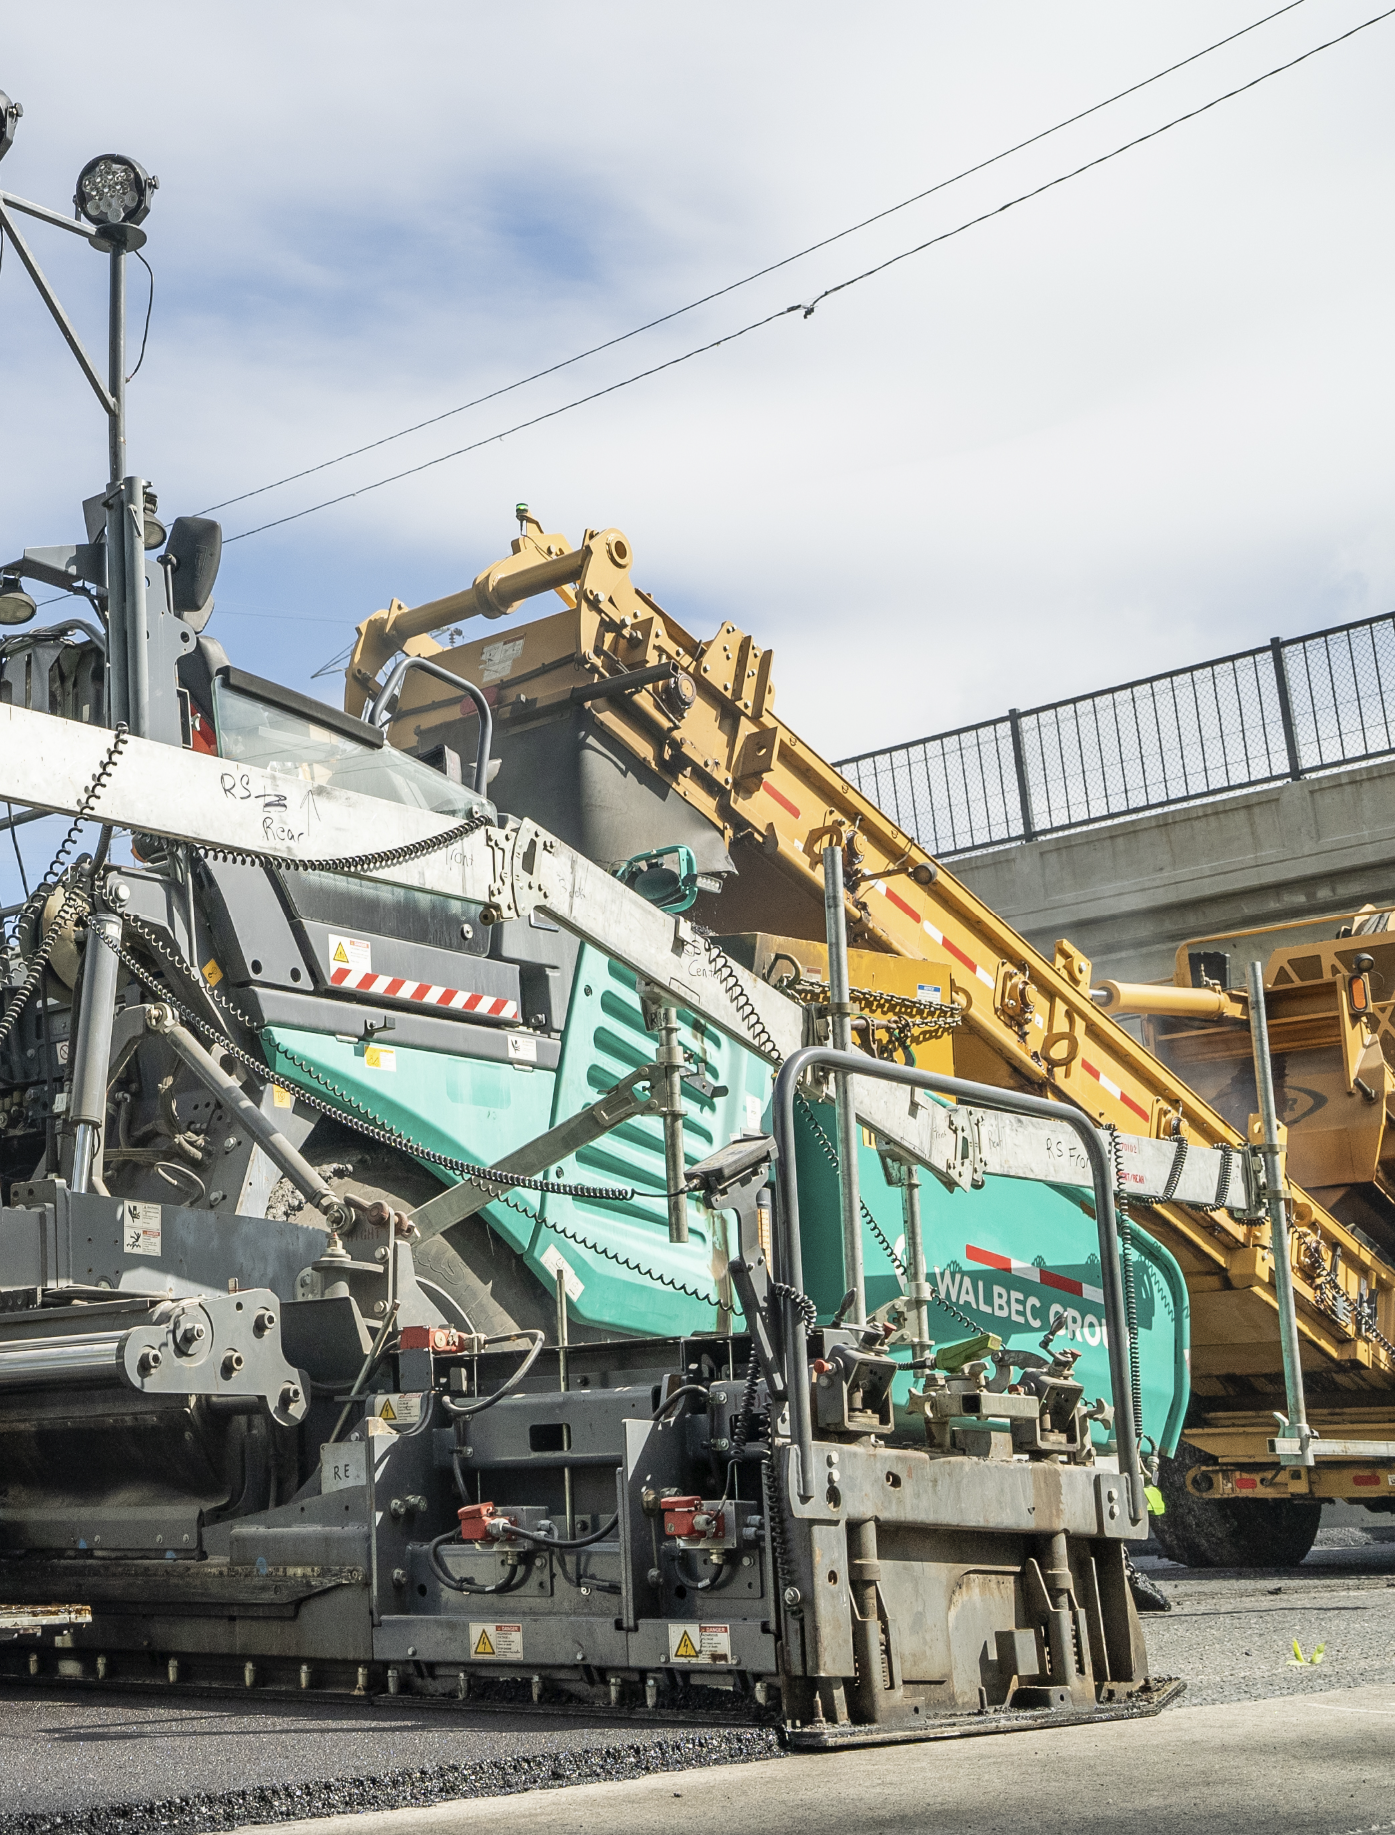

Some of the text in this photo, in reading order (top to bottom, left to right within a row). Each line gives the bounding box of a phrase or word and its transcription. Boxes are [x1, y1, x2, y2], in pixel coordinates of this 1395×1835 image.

[220, 772, 252, 800] RS
[262, 816, 305, 844] Rear
[933, 1265, 1129, 1348] WALBEC GRO
[333, 1463, 350, 1481] RE
